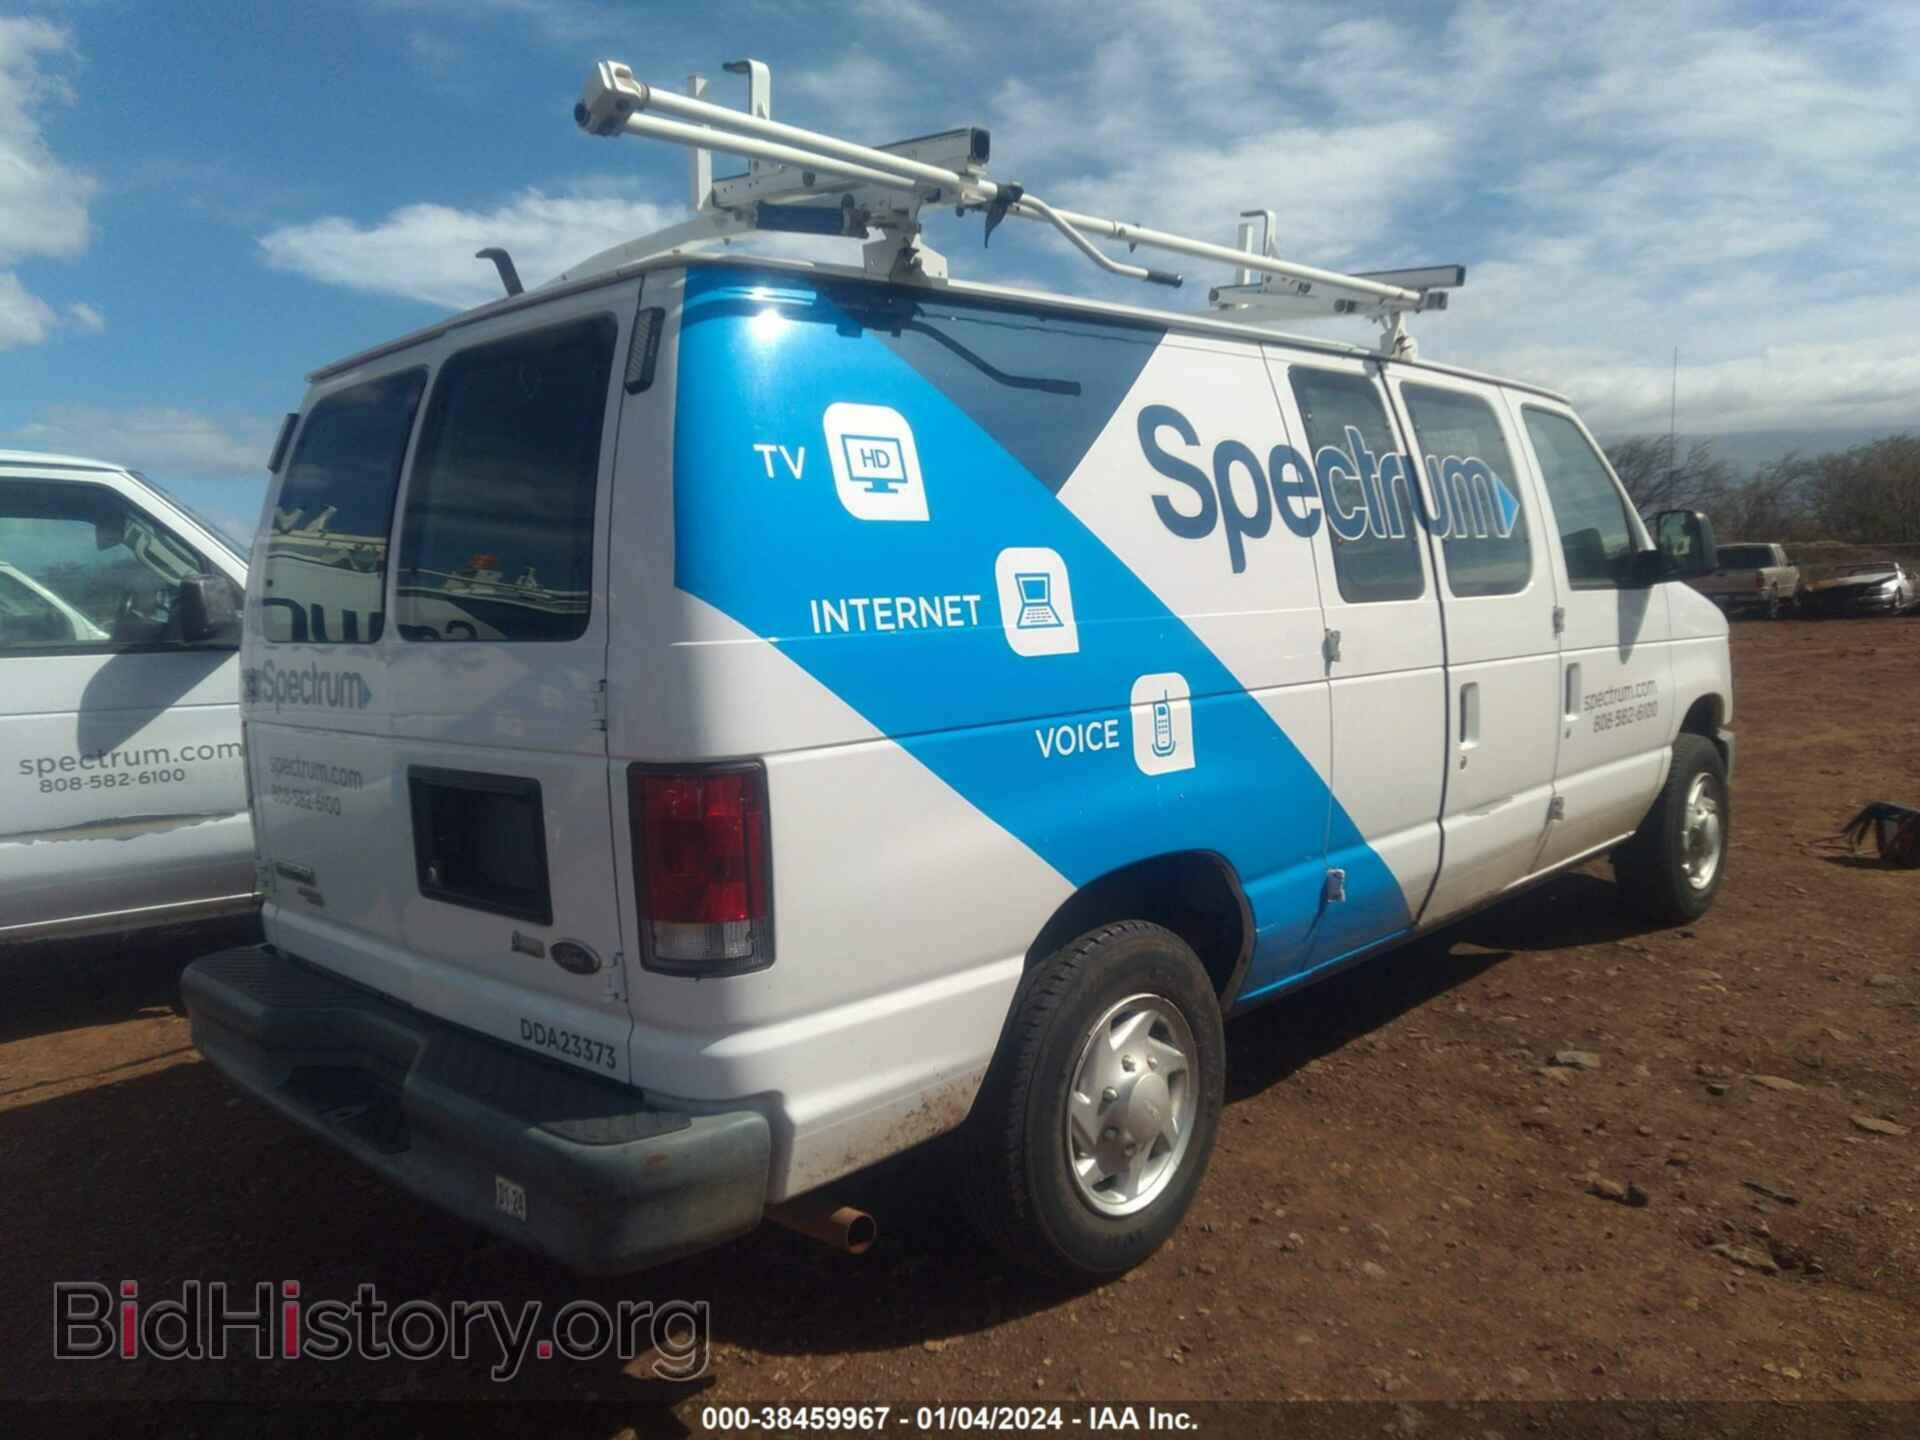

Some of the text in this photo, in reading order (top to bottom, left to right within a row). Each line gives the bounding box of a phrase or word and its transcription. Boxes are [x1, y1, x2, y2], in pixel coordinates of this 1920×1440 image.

[753, 444, 805, 480] TV
[860, 448, 890, 469] HD
[1137, 404, 1512, 574] Spectrum
[810, 594, 981, 634] INTERNET
[263, 659, 368, 714] Spectrum
[1583, 680, 1657, 713] spectrum.com
[1035, 719, 1120, 758] VOICE
[19, 741, 243, 778] spectrum.com
[39, 769, 185, 793] 808-582-6100
[520, 1018, 616, 1069] DDA23373
